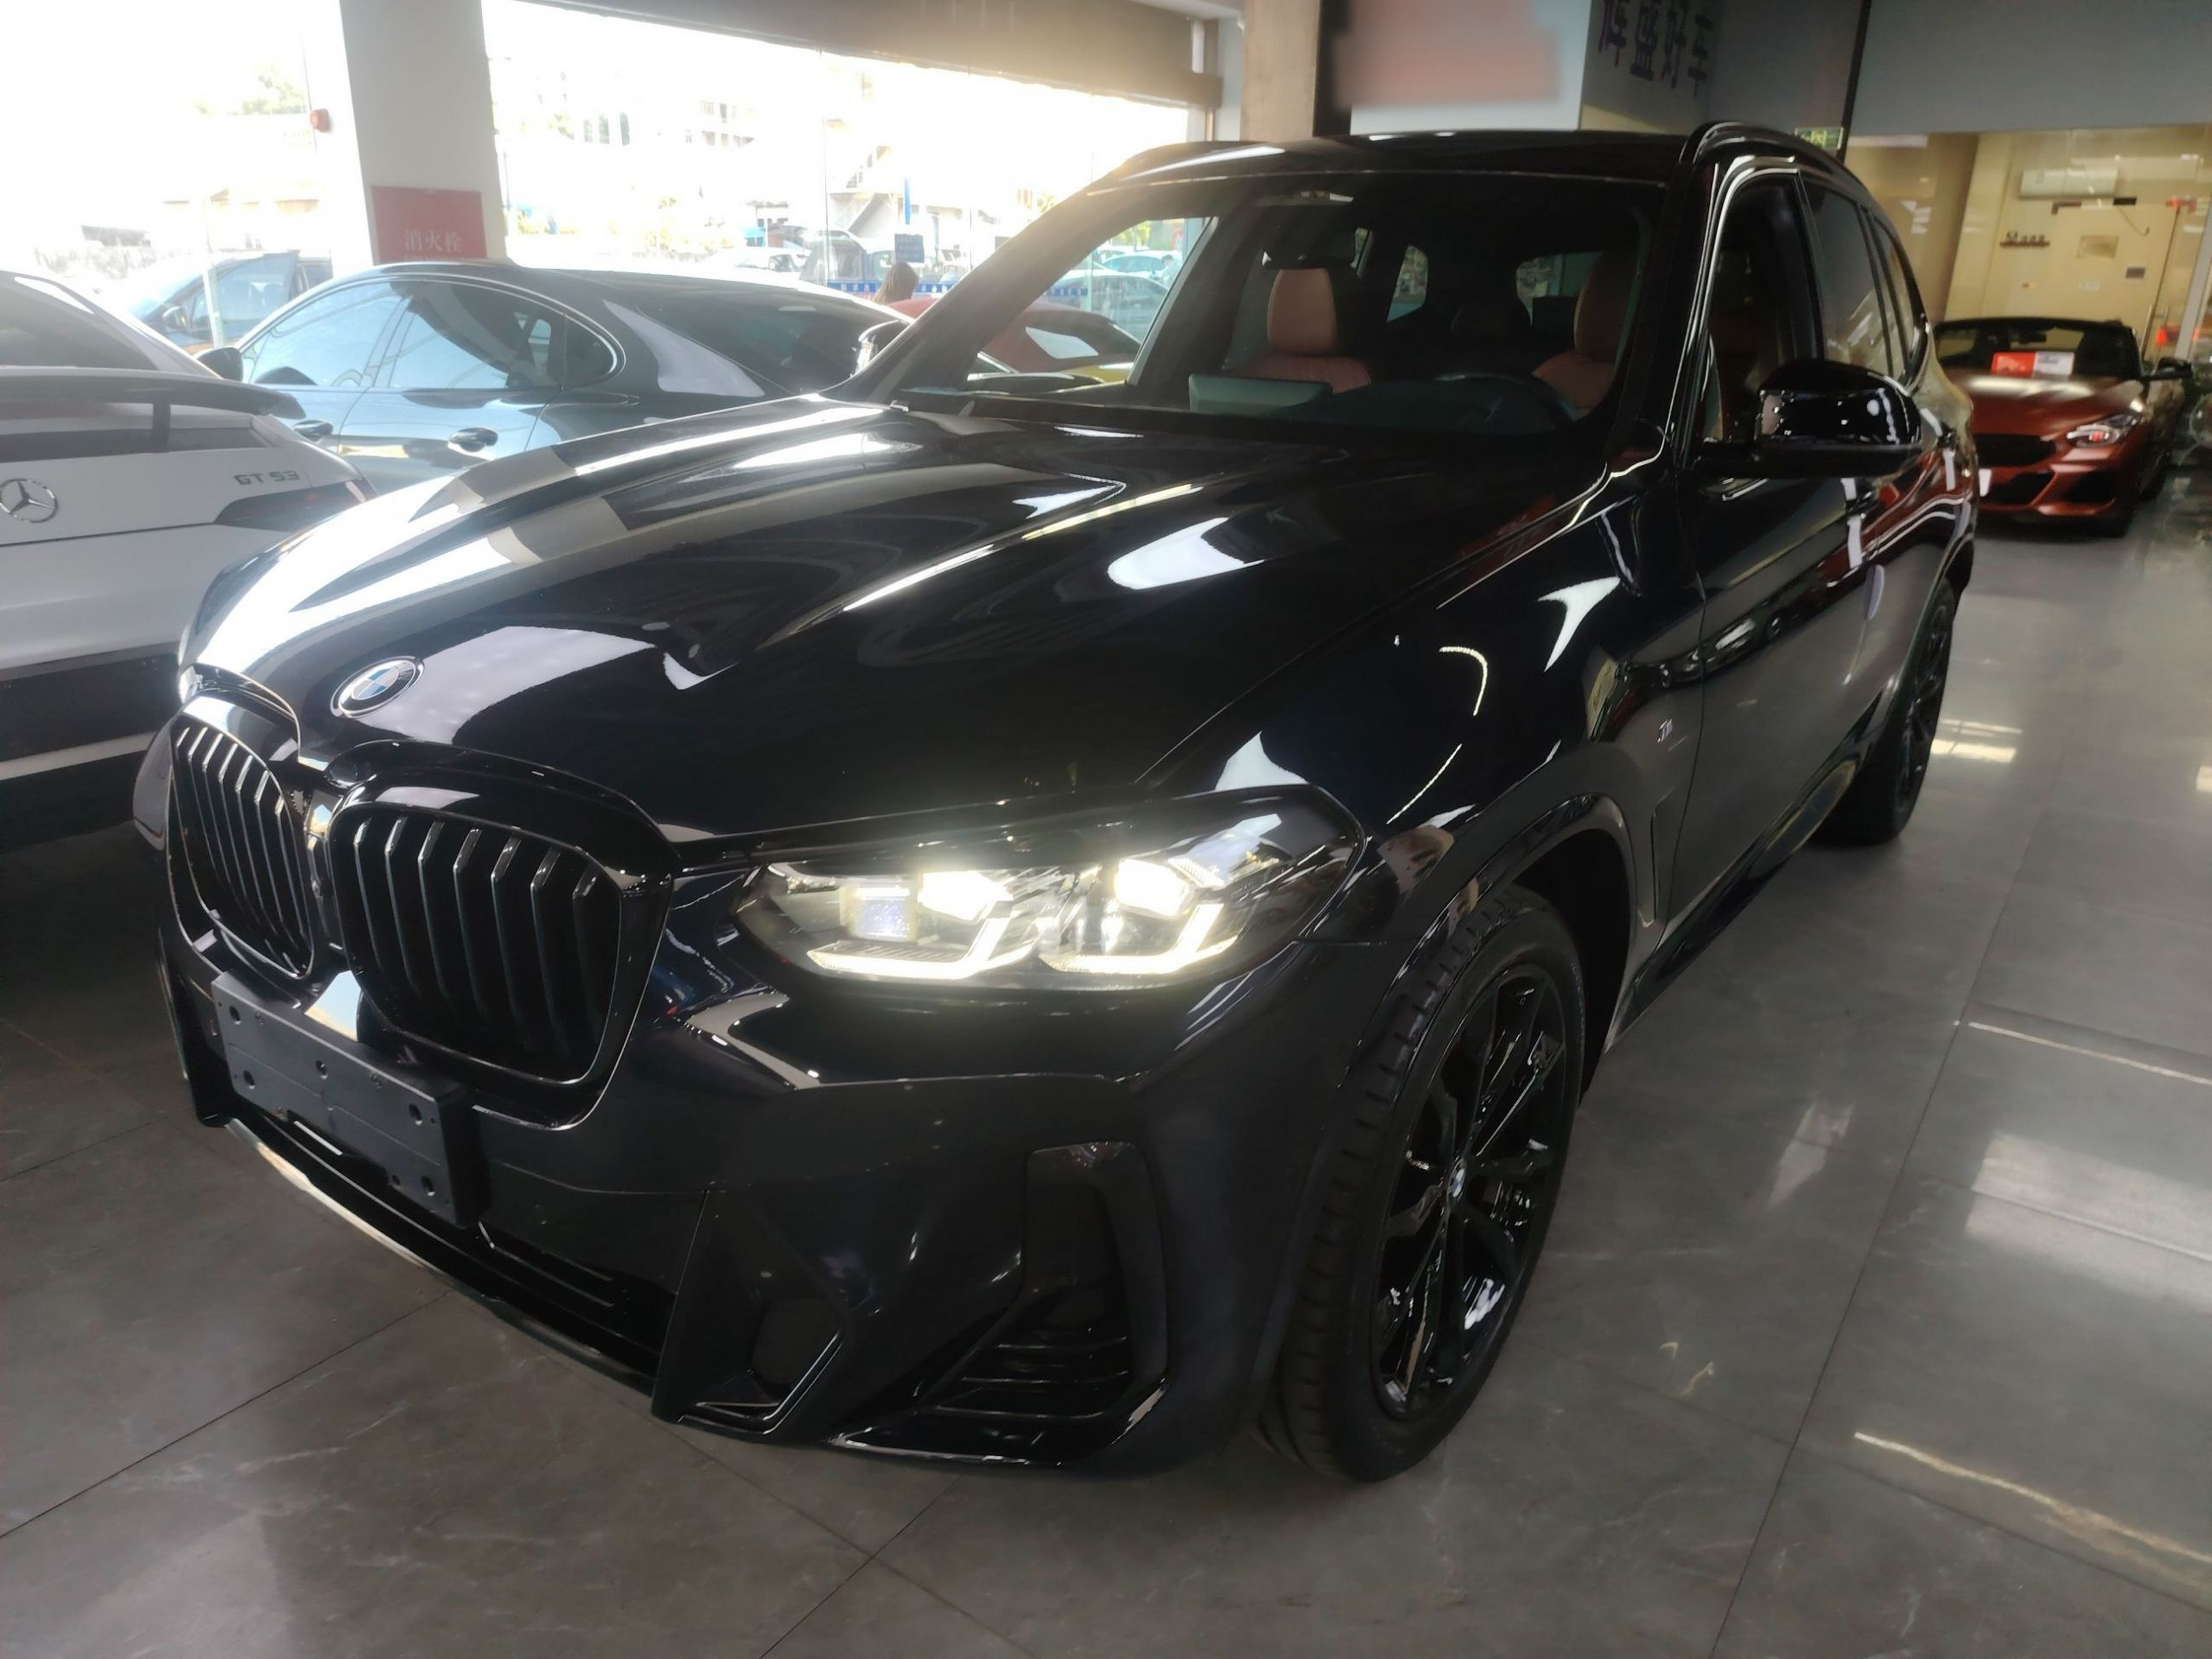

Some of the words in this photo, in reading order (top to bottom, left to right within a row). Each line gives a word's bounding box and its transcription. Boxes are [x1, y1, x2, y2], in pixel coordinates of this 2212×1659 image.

[404, 229, 463, 252] 消火栓
[233, 473, 264, 485] GT
[269, 471, 300, 482] 53
